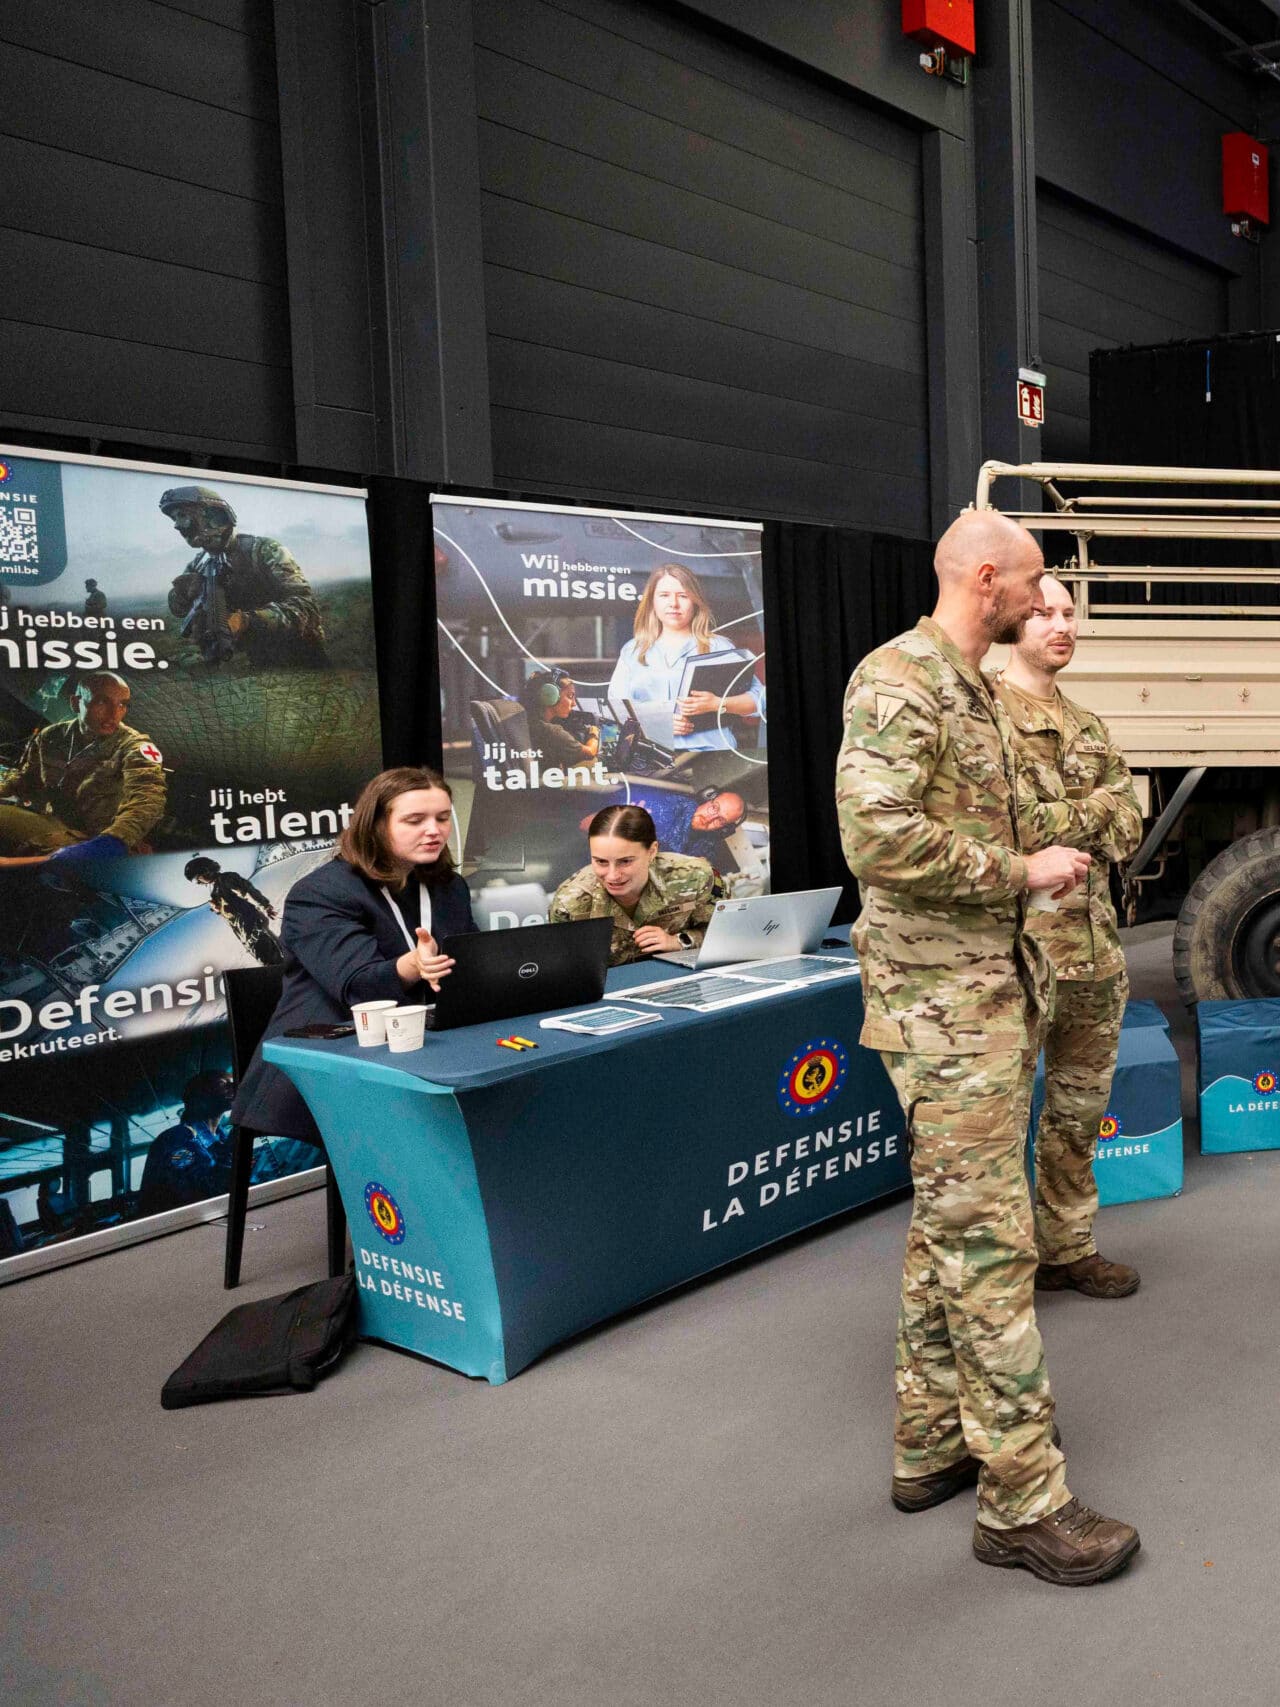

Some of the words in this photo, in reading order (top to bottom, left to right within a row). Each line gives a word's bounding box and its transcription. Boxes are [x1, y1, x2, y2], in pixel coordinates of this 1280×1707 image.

[0, 492, 38, 503] NSIE
[0, 565, 39, 575] .mil.be
[520, 553, 559, 573] Wij
[562, 562, 608, 573] hebben
[609, 566, 631, 574] een
[523, 572, 645, 601] missie.
[18, 610, 115, 629] hebben
[122, 617, 165, 631] een
[483, 743, 507, 763] Jij
[510, 748, 543, 759] hebt
[483, 761, 619, 791] talent.
[210, 788, 233, 810] Jij
[239, 788, 287, 805] hebt
[0, 966, 226, 1040] Defensi
[0, 1027, 123, 1063] ekruteert.
[1228, 1104, 1244, 1113] LA
[728, 1110, 881, 1187] DEFENSIE
[1098, 1143, 1150, 1159] ÉFENSE
[703, 1197, 745, 1233] LA
[760, 1135, 898, 1208] DÉFENSE
[360, 1247, 446, 1290] DEFENSIE
[358, 1270, 378, 1292] LA
[380, 1280, 467, 1322] DÉFENSE
